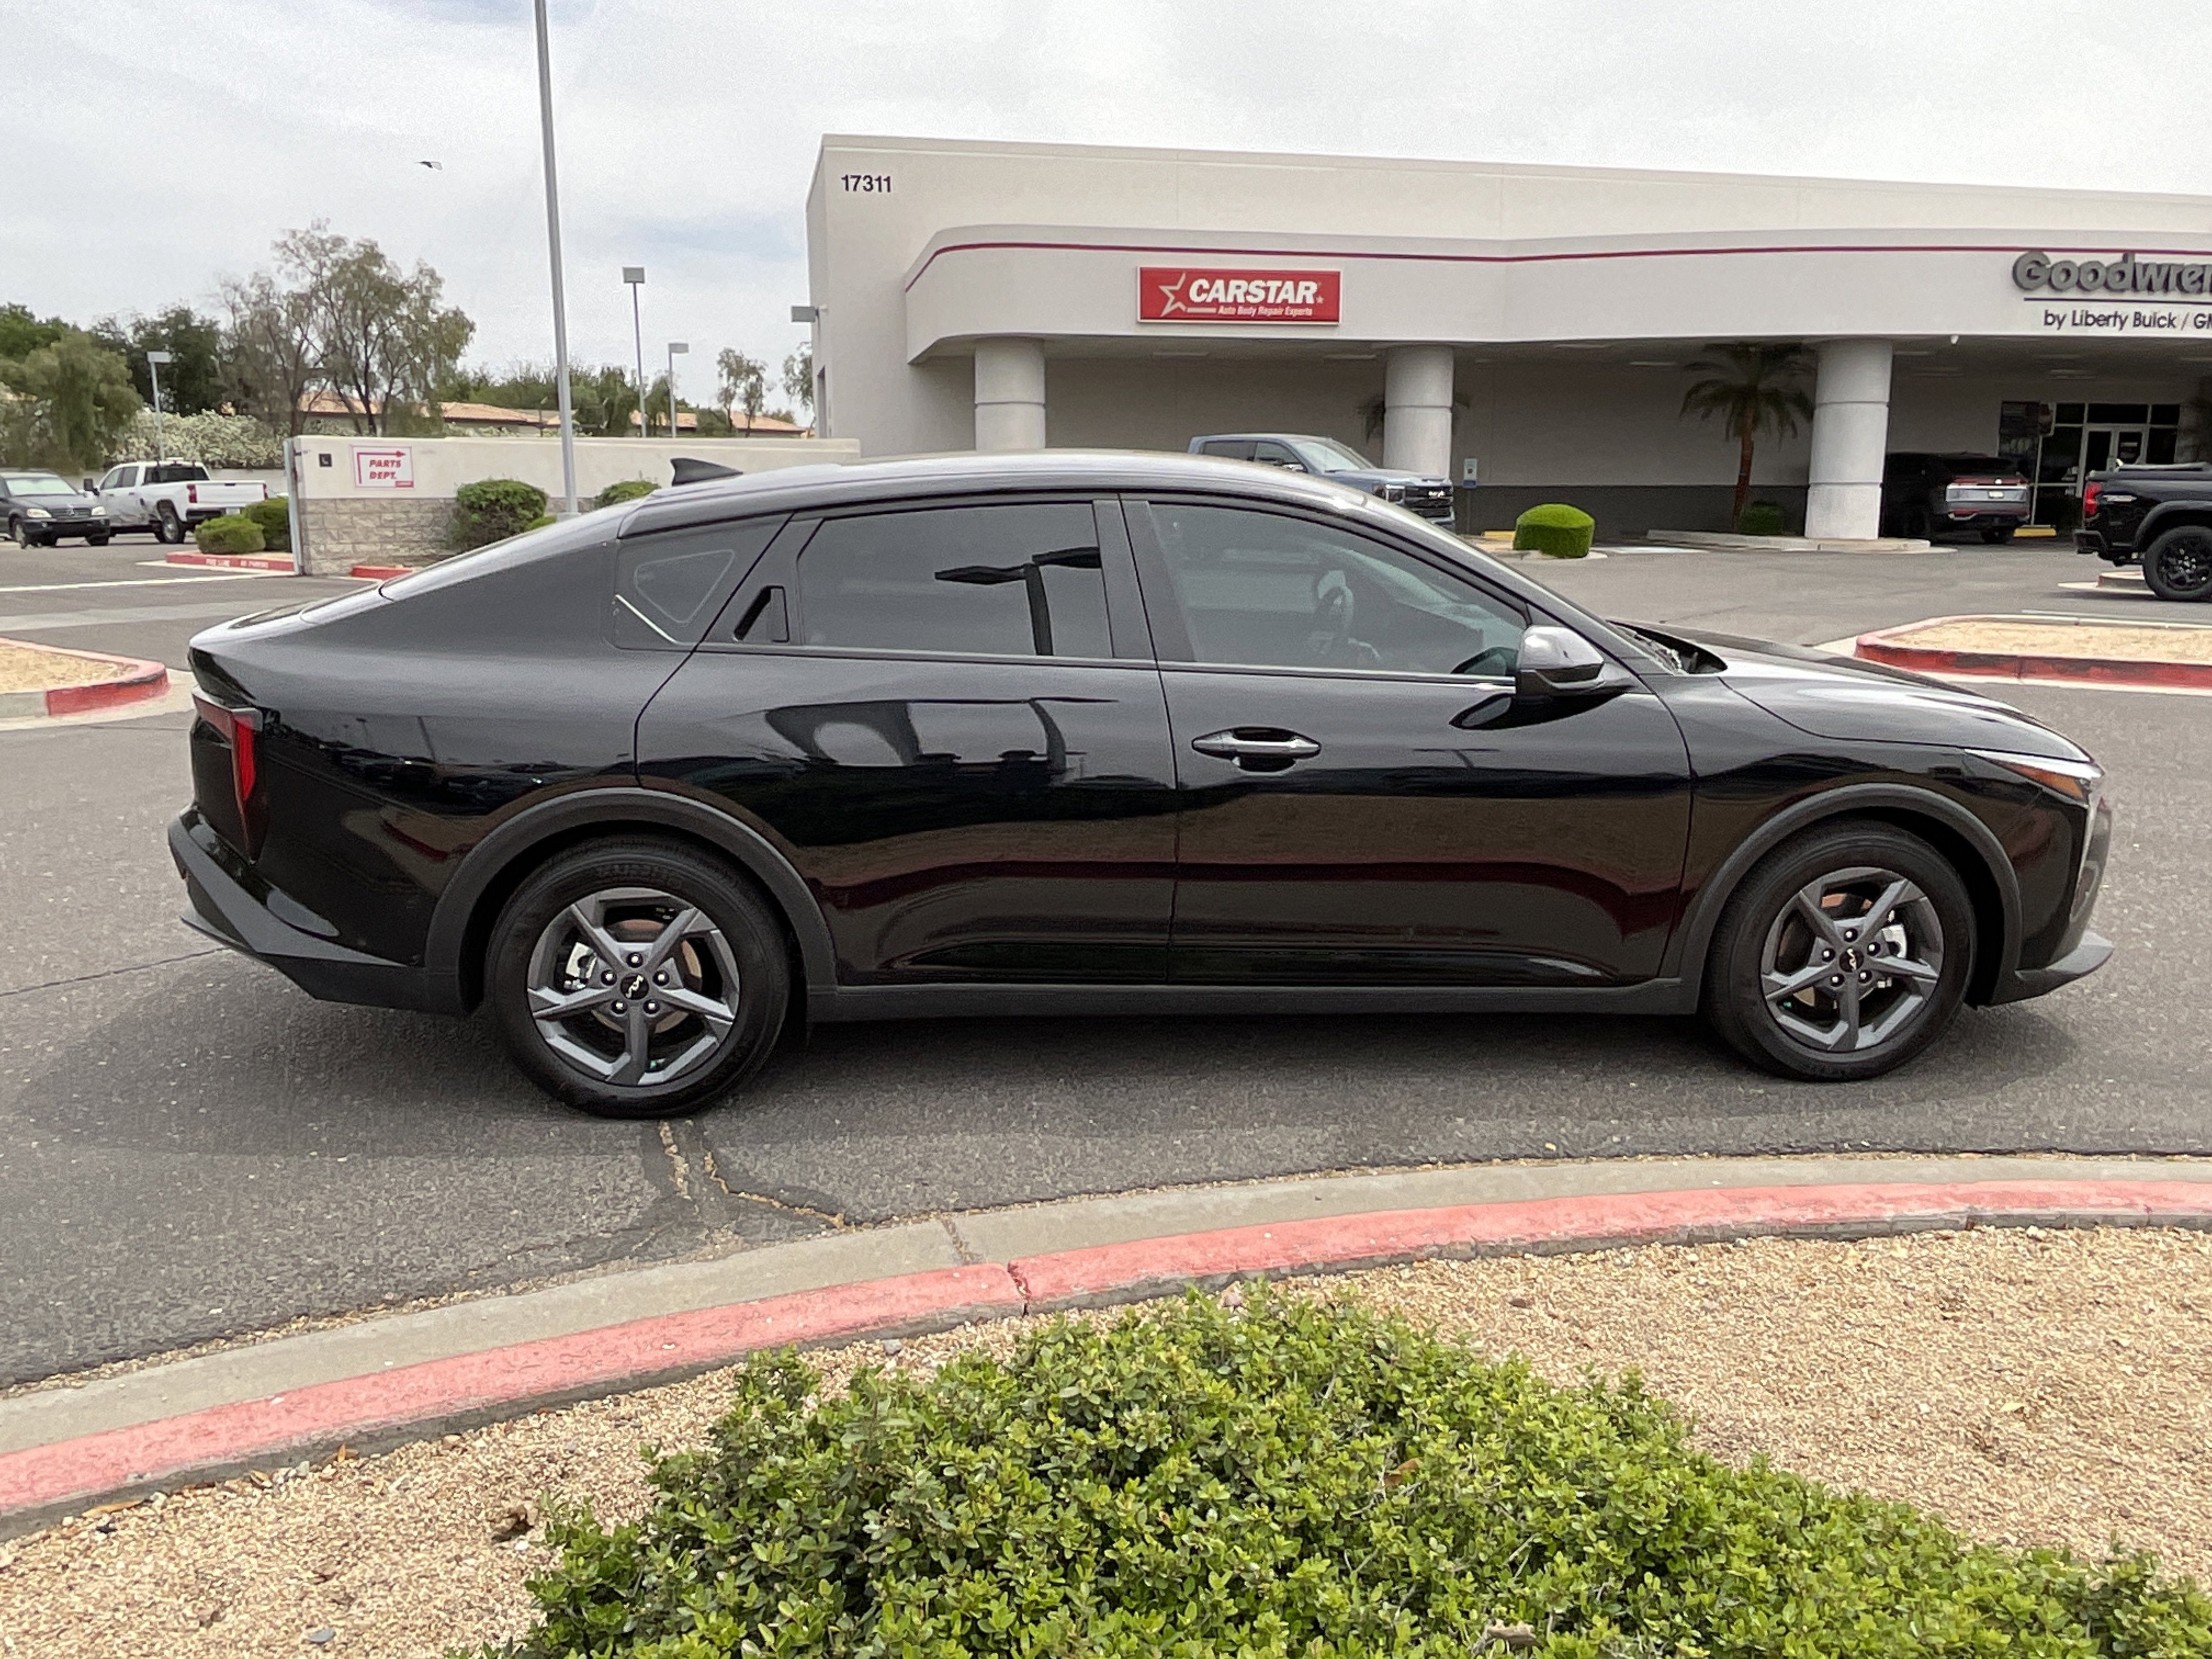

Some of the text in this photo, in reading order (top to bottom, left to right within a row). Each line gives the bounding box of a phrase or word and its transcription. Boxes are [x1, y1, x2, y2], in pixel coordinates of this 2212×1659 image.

[841, 174, 891, 193] 17311
[1189, 279, 1318, 303] CARSTAR
[2044, 309, 2067, 330] by
[2072, 310, 2129, 330] Liberty
[2133, 311, 2176, 328] Buick
[2181, 312, 2190, 331] /
[369, 459, 401, 467] PARTS
